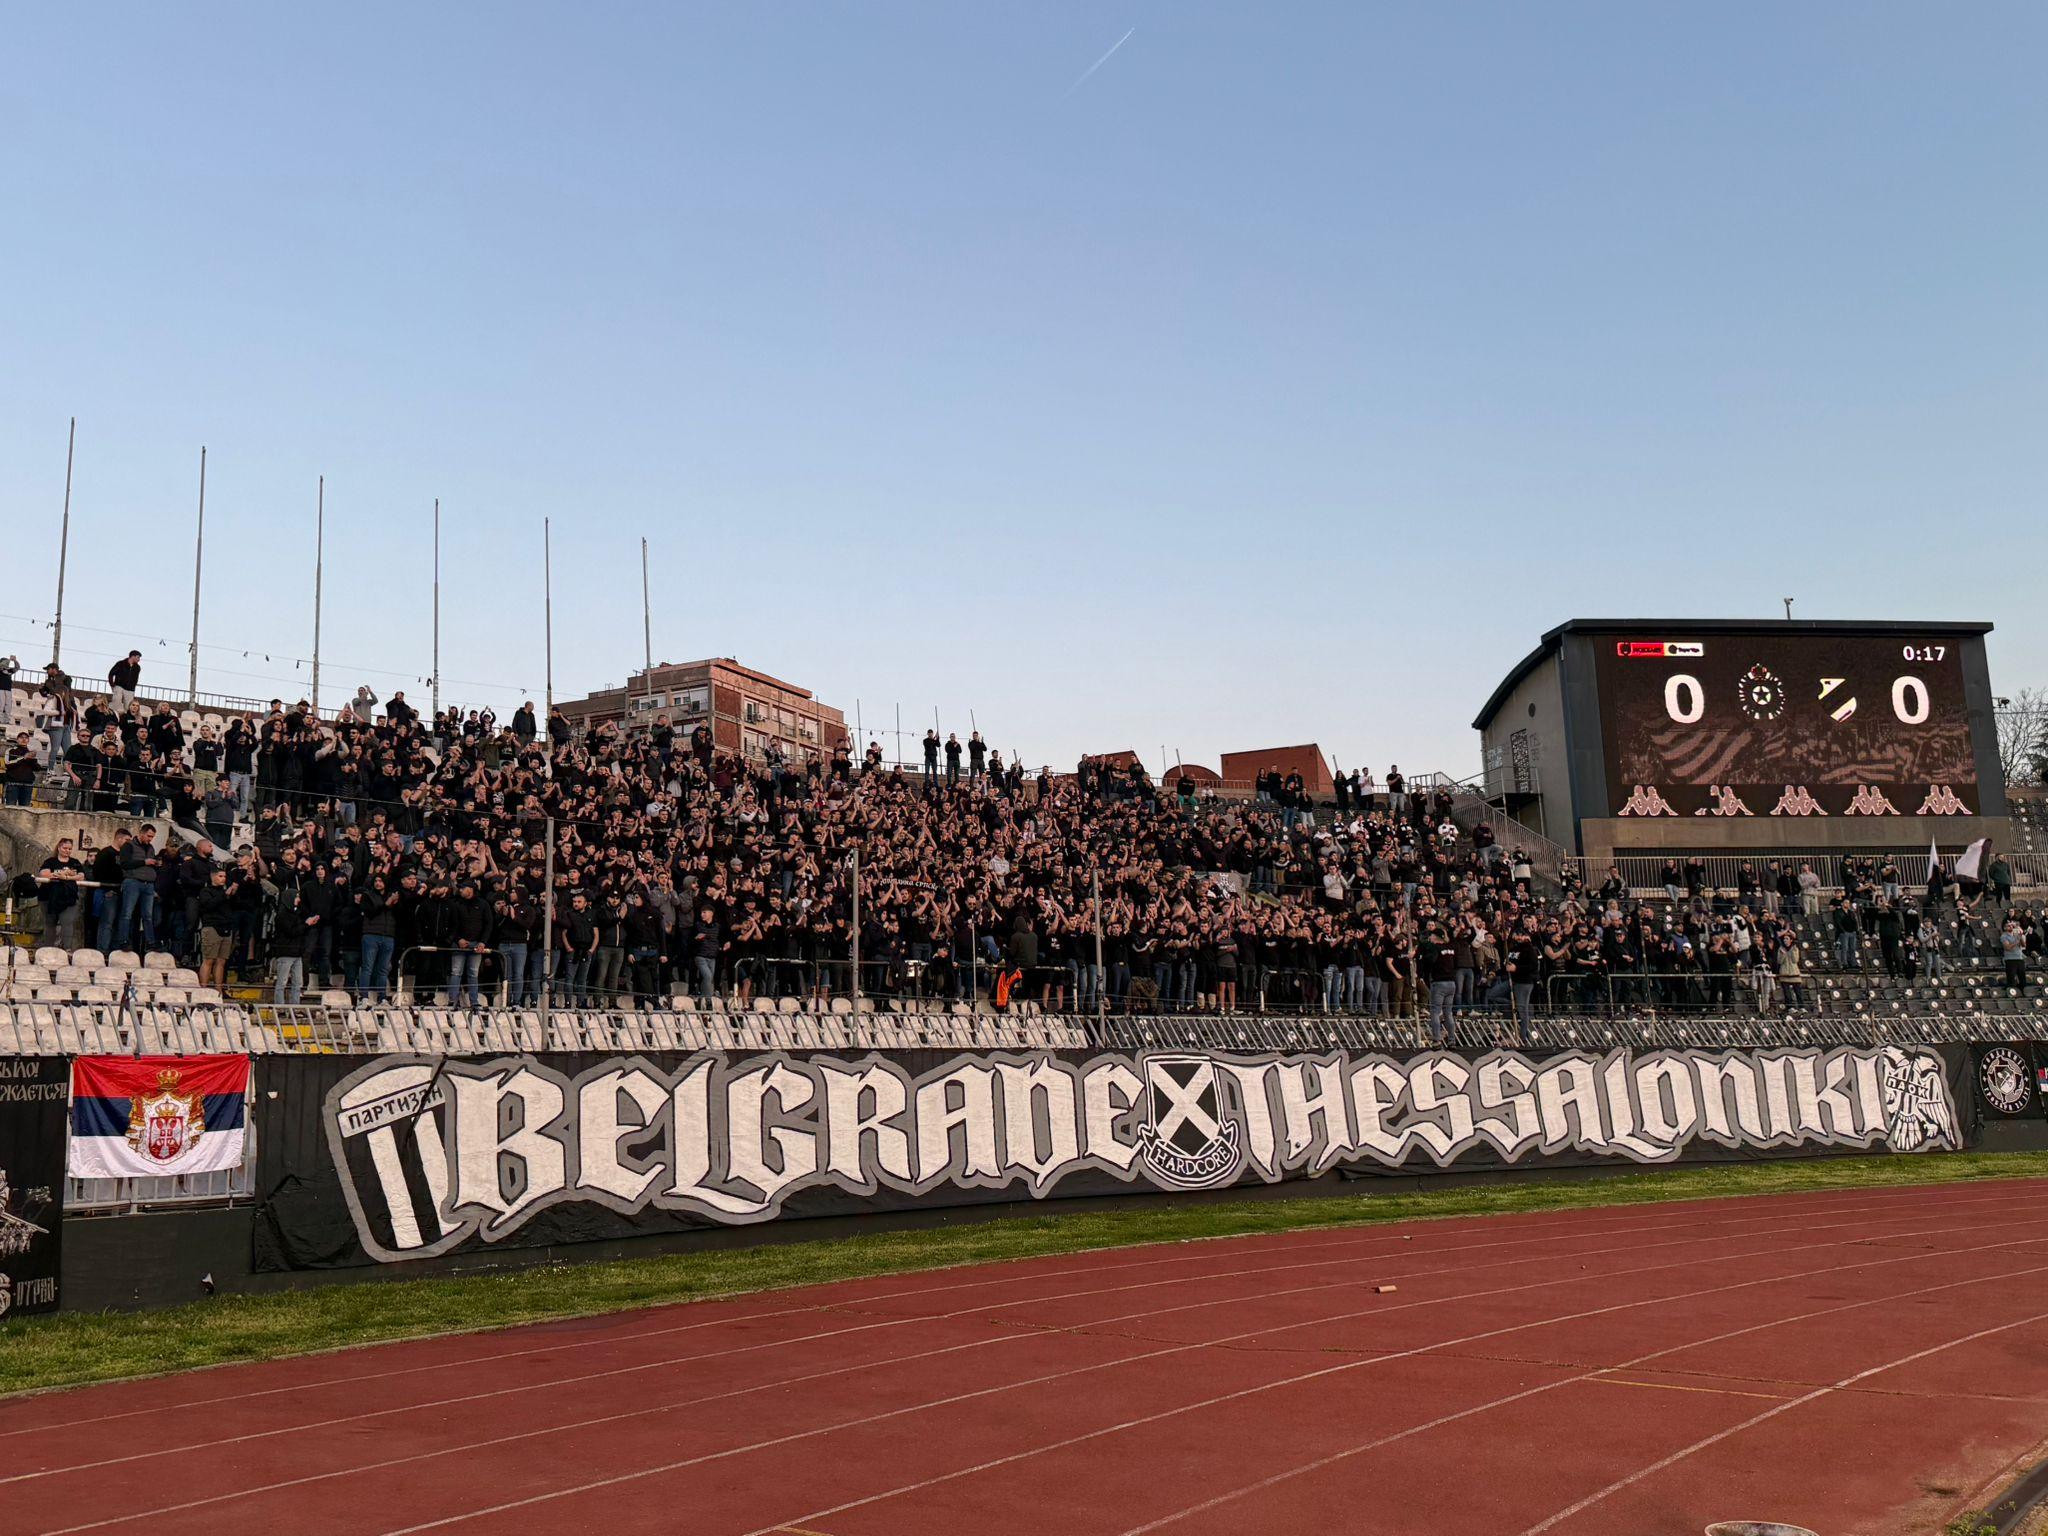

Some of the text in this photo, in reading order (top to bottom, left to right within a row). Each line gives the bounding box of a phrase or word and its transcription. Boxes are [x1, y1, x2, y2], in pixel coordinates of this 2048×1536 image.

[1903, 646, 1946, 662] 0:17
[1664, 674, 1704, 723] 0
[1892, 676, 1930, 724] 0
[446, 1057, 1145, 1230] BELGRADE
[1212, 1051, 1890, 1175] THESSALONIKI
[1154, 1147, 1232, 1176] HARDCORE
